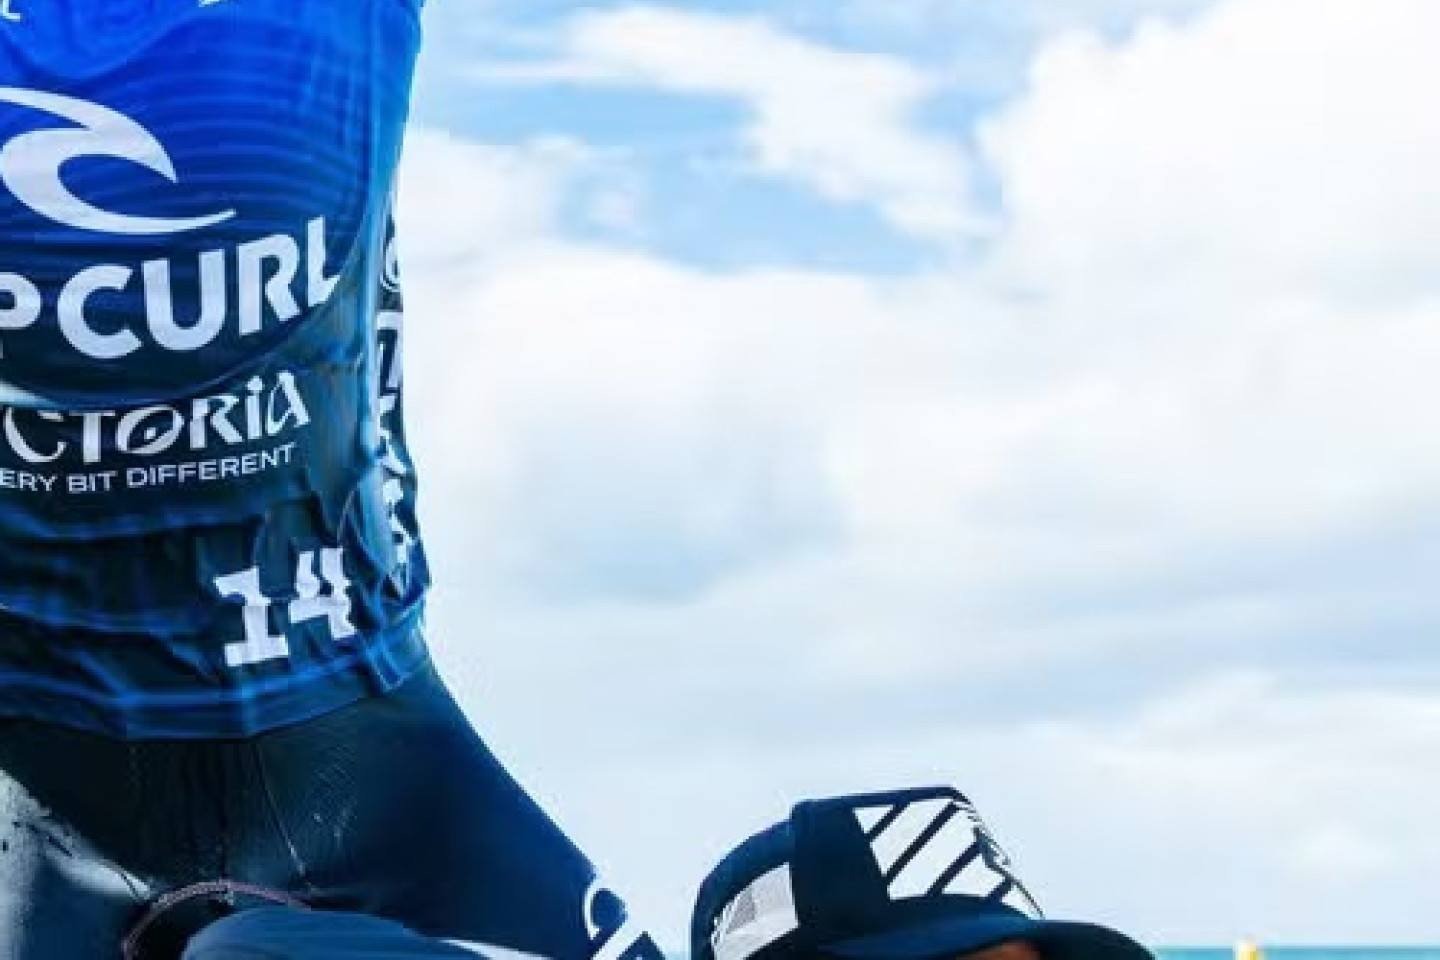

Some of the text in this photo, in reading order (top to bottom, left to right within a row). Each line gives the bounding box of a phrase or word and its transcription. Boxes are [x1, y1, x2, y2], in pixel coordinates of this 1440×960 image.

[57, 215, 341, 359] CURL
[66, 470, 118, 494] BIT
[126, 441, 296, 488] DIFFERENT
[213, 547, 357, 667] 14
